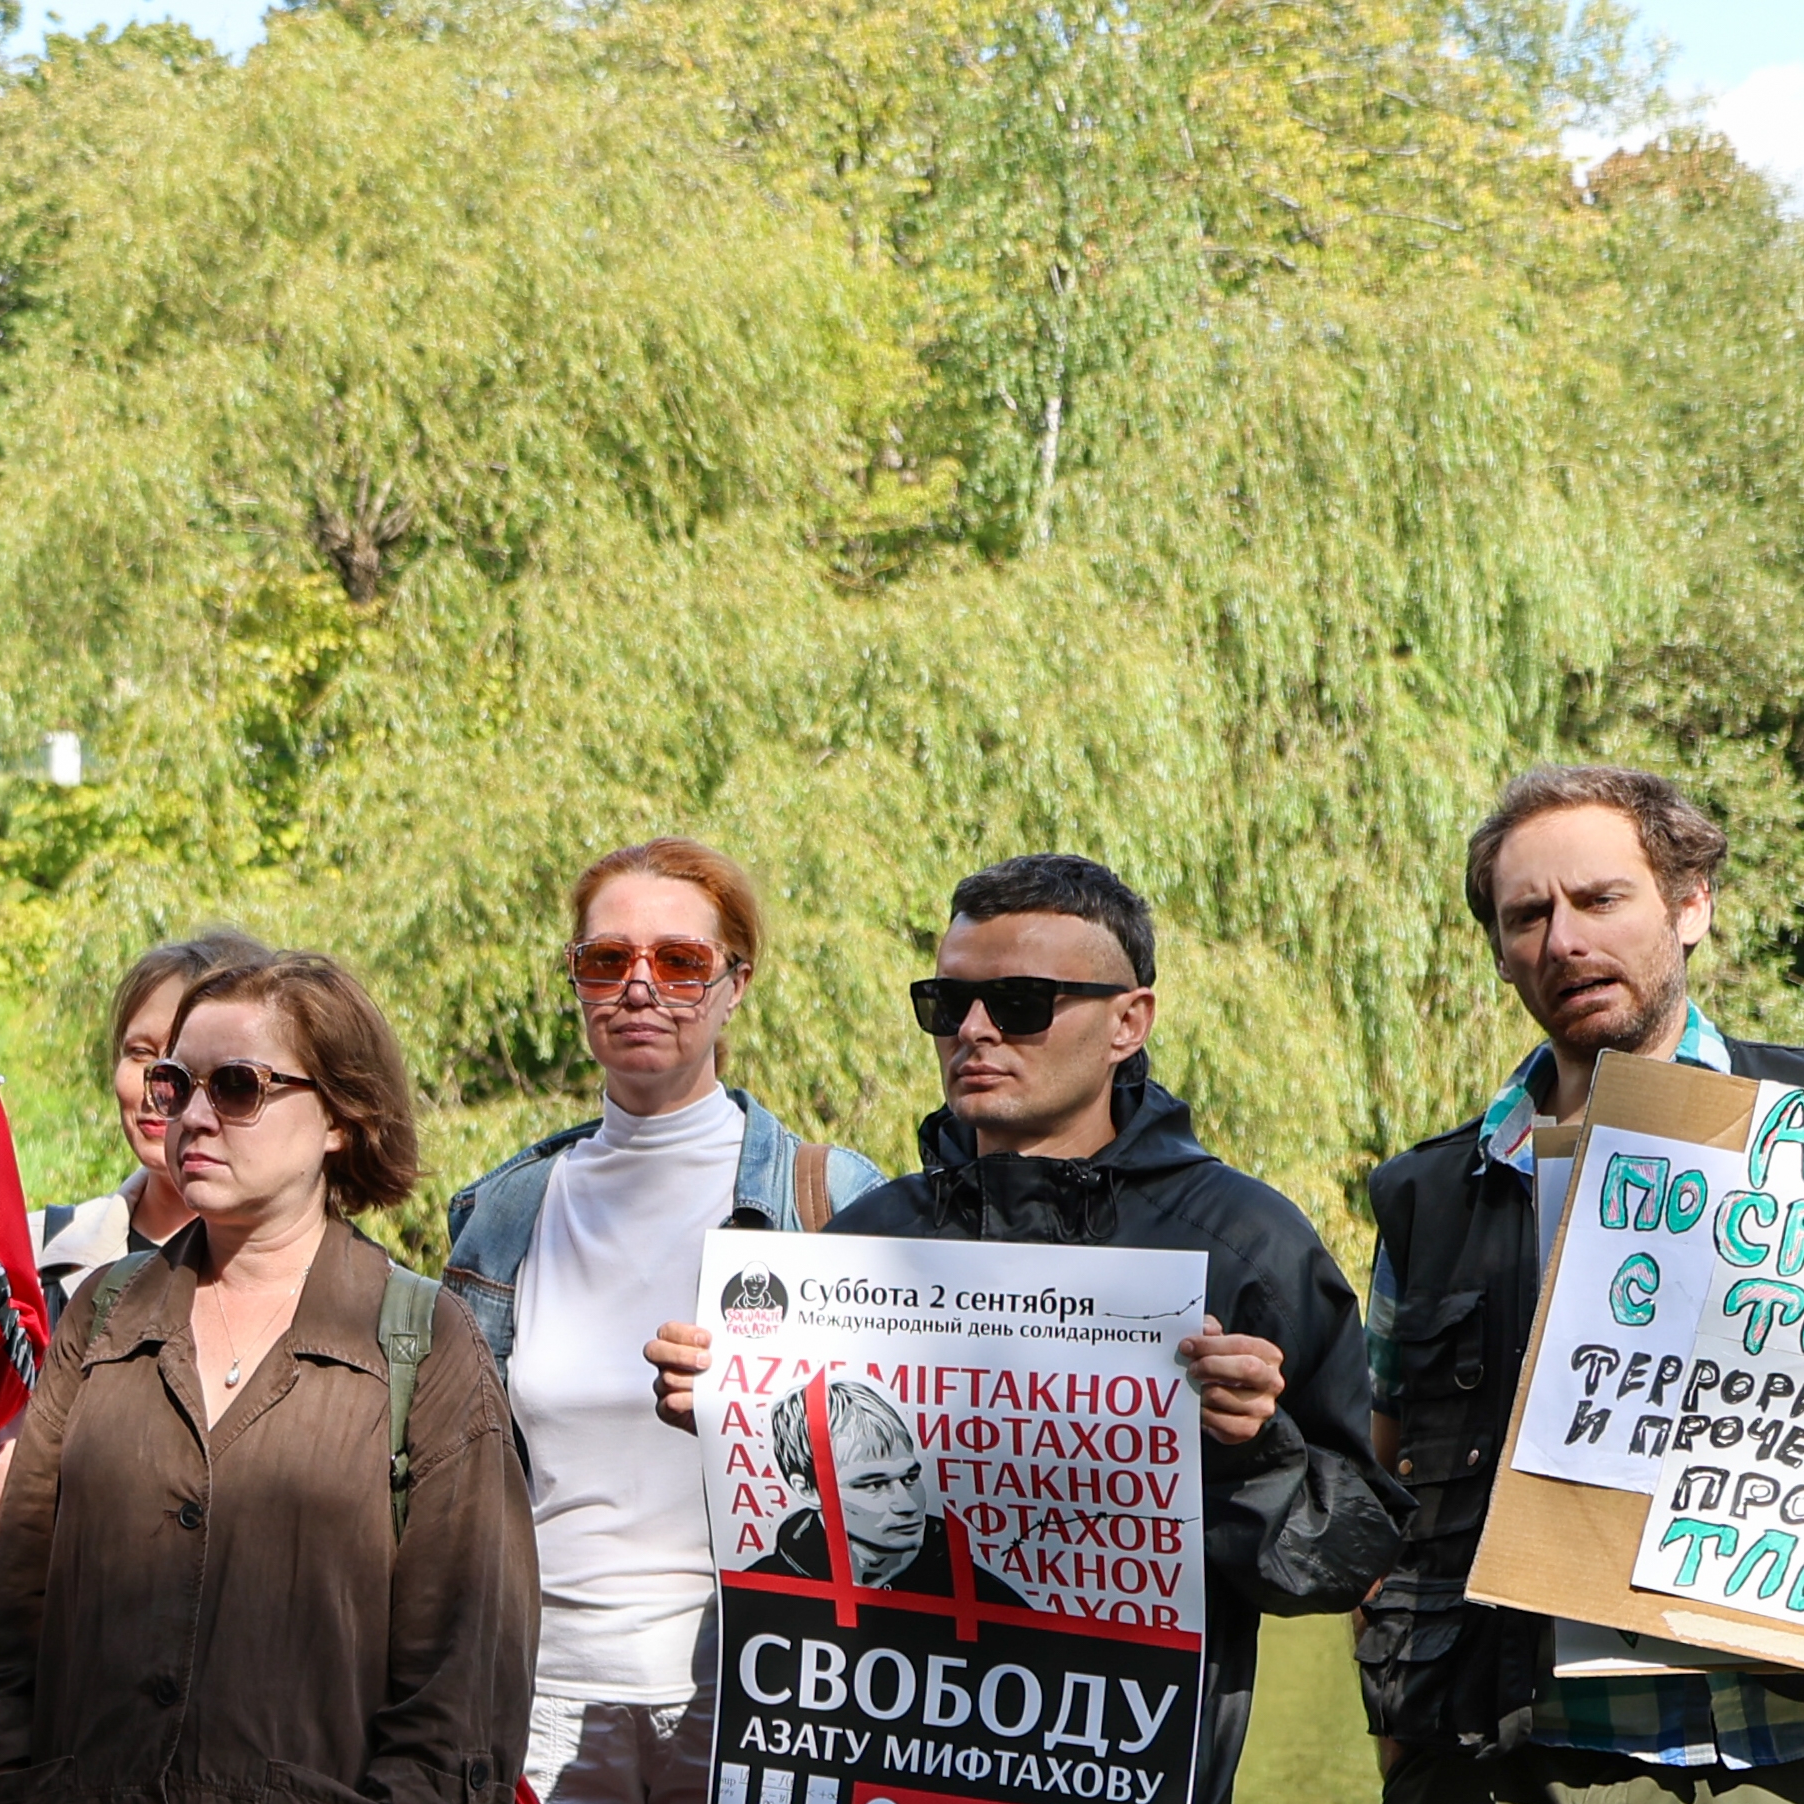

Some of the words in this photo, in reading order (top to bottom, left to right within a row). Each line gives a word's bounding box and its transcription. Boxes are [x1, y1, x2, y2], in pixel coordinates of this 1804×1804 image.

[799, 1276, 919, 1311] Суббота
[929, 1284, 945, 1309] 2
[953, 1286, 1094, 1323] сентября
[797, 1308, 961, 1335] Международный
[966, 1322, 1014, 1338] день
[1020, 1318, 1161, 1352] солидарности
[737, 1636, 1179, 1754] СВОБОДУ
[740, 1716, 872, 1764] АЗАТУ
